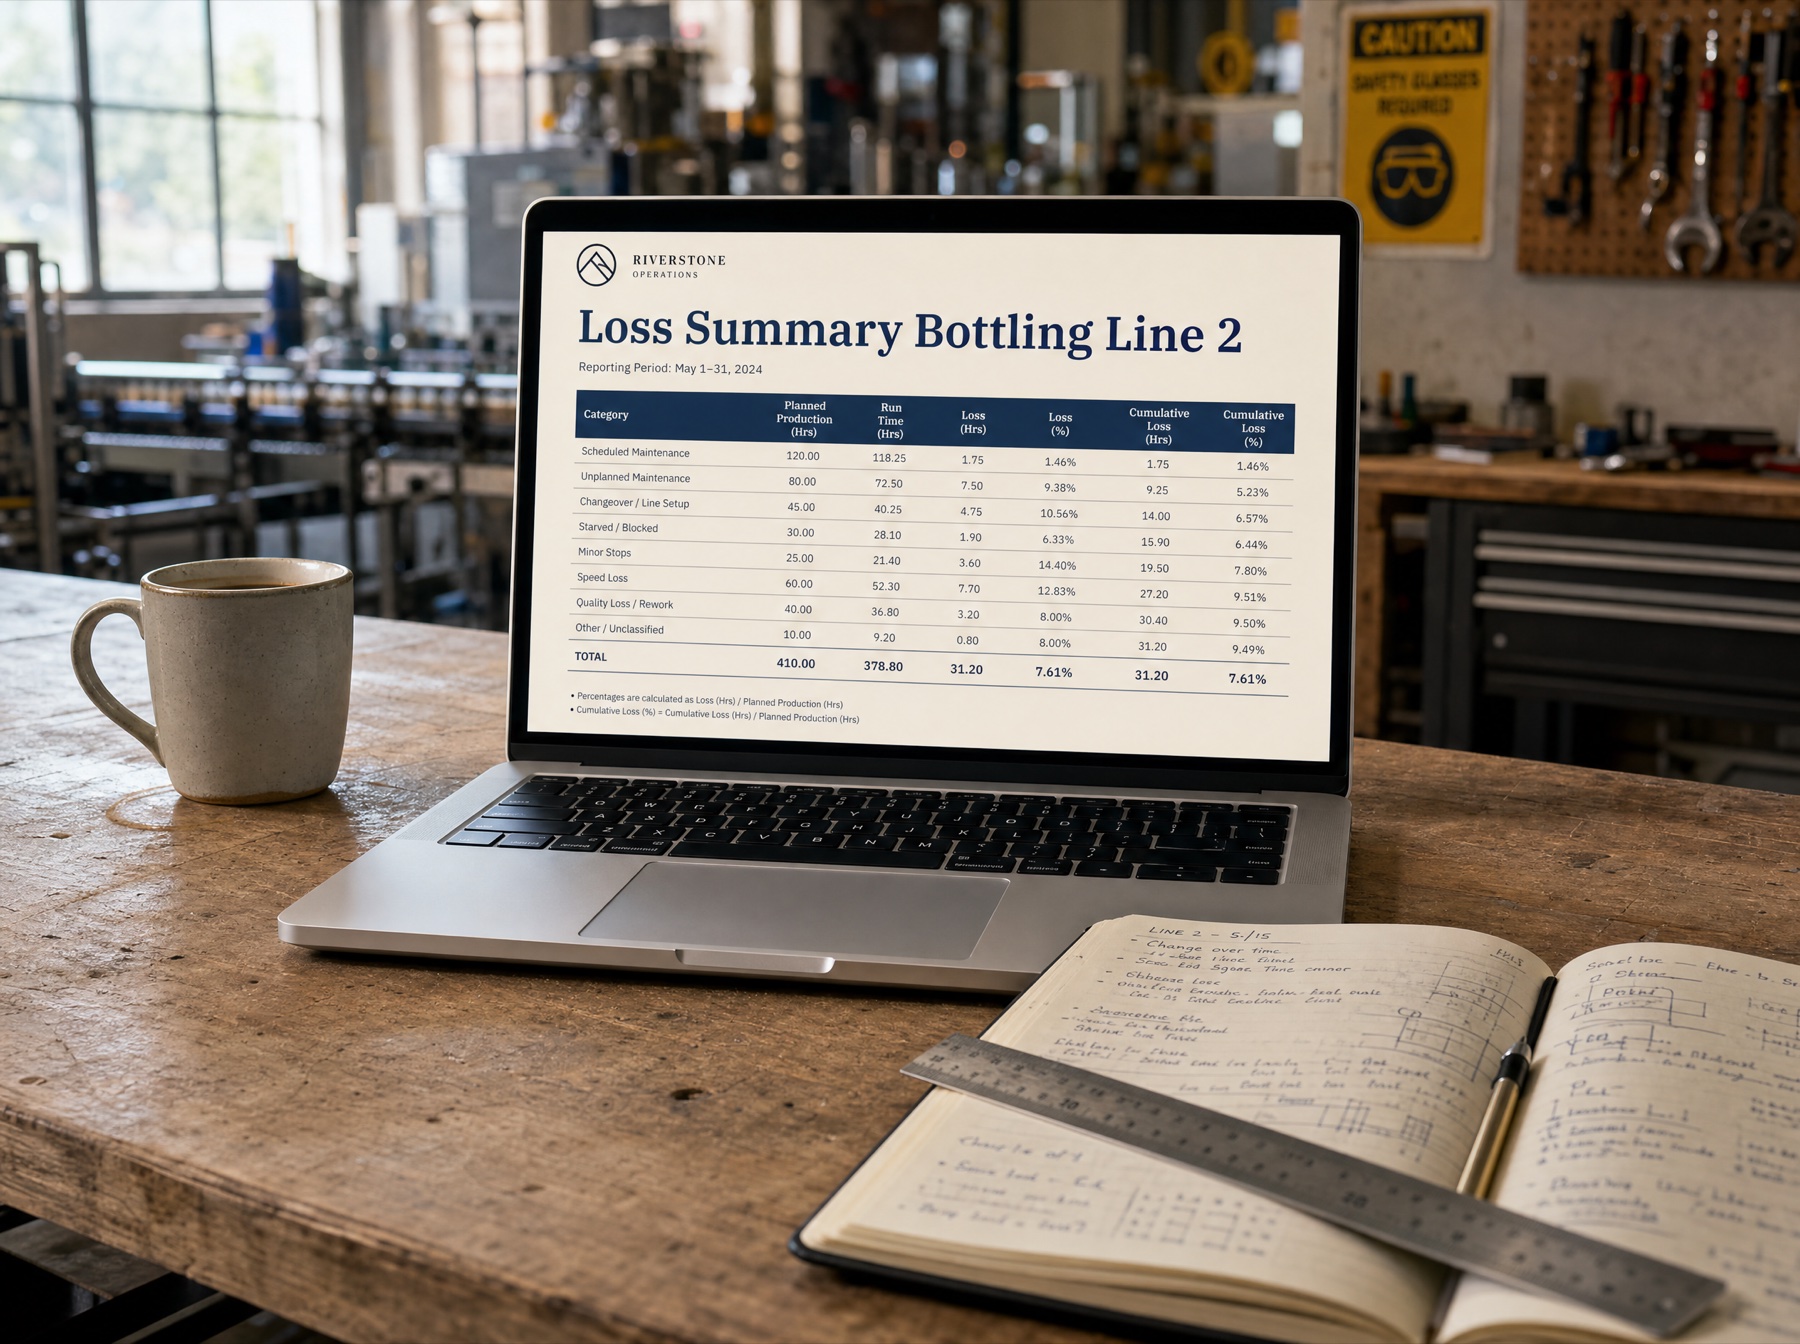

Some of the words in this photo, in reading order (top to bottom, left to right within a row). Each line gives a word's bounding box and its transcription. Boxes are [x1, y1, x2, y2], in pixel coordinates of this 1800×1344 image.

[1360, 19, 1477, 55] CAUTION
[1354, 72, 1406, 93] SAFETY
[1412, 69, 1479, 90] GLASSES
[1377, 97, 1453, 117] REQUIRED
[633, 255, 726, 266] RIVERSTONE
[579, 309, 672, 344] Loss
[686, 310, 903, 357] Summary
[915, 313, 1094, 361] Bottling
[1106, 314, 1204, 353] Line
[1218, 318, 1241, 353] 2
[579, 361, 631, 375] Reporting
[634, 362, 671, 373] Period:
[675, 363, 697, 376] May
[734, 364, 763, 374] 2024
[784, 401, 826, 410] Planned
[881, 403, 902, 412] Run
[584, 409, 629, 422] Category
[962, 410, 986, 420] Loss
[1049, 412, 1073, 422] Loss
[1129, 407, 1190, 418] Cumulative
[1223, 410, 1285, 420] Cumulative
[776, 414, 833, 424] Production
[877, 416, 904, 426] Time
[960, 424, 987, 436] (Hrs)
[1051, 425, 1070, 437] (%)
[1147, 421, 1171, 431] Loss
[1242, 424, 1266, 433] Loss
[791, 427, 817, 438] (Hrs)
[877, 428, 904, 440] (Hrs)
[1145, 434, 1172, 446] (Hrs)
[1244, 436, 1263, 448] (%)
[582, 446, 629, 456] Scheduled
[632, 448, 690, 458] Maintenance
[787, 451, 820, 461] 120.00
[873, 453, 906, 463] 118.25
[962, 455, 984, 465] 1.75
[1045, 457, 1076, 467] 1.46%
[1147, 459, 1169, 469] 1.75
[1237, 461, 1269, 471] 1.46%
[581, 472, 630, 483] Unplanned
[632, 473, 691, 483] Maintenance
[789, 476, 816, 486] 80.00
[875, 479, 903, 488] 72.50
[961, 481, 983, 491] 7.50
[1044, 483, 1076, 493] 9.38%
[1146, 485, 1168, 495] 9.25
[1237, 487, 1269, 497] 5.23%
[580, 497, 634, 509] Changeover
[642, 498, 661, 508] Line
[663, 498, 690, 510] Setup
[787, 502, 815, 512] 45.00
[874, 505, 902, 514] 40.25
[960, 507, 982, 516] 4.75
[1041, 509, 1078, 519] 10.56%
[1142, 511, 1171, 521] 14.00
[1236, 514, 1268, 524] 6.57%
[579, 522, 613, 532] Starved
[622, 523, 658, 533] Blocked
[787, 528, 814, 537] 30.00
[874, 530, 901, 540] 28.10
[960, 532, 982, 542] 1.90
[1043, 535, 1074, 544] 6.33%
[1142, 537, 1170, 547] 15.90
[1235, 540, 1268, 550] 6.44%
[578, 547, 604, 557] Minor
[606, 547, 631, 559] Stops
[786, 553, 814, 563] 25.00
[873, 555, 901, 565] 21.40
[959, 558, 981, 568] 3.60
[1039, 560, 1076, 570] 14.40%
[1141, 563, 1169, 573] 19.50
[1234, 566, 1267, 576] 7.80%
[577, 572, 605, 583] Speed
[608, 573, 628, 583] Loss
[785, 579, 813, 589] 60.00
[872, 581, 900, 591] 52.30
[958, 584, 980, 594] 7.70
[1038, 586, 1076, 596] 12.83%
[1140, 589, 1169, 599] 27.20
[1234, 592, 1266, 602] 9.51%
[576, 597, 608, 609] Quality
[610, 599, 631, 608] Loss
[639, 599, 674, 609] Rework
[784, 605, 812, 614] 40.00
[871, 607, 899, 617] 36.80
[958, 610, 980, 619] 3.20
[1040, 612, 1072, 622] 8.00%
[1139, 615, 1168, 625] 30.40
[1233, 618, 1266, 628] 9.50%
[575, 623, 601, 632] Other
[609, 624, 664, 635] Unclassified
[784, 630, 811, 640] 10.00
[873, 633, 896, 642] 9.20
[957, 635, 979, 645] 0.80
[1039, 638, 1071, 648] 8.00%
[1138, 641, 1167, 651] 31.20
[1232, 644, 1265, 655] 9.49%
[575, 651, 607, 662] TOTAL
[777, 658, 816, 669] 410.00
[864, 660, 903, 672] 378.80
[950, 663, 983, 675] 31.20
[1036, 666, 1073, 678] 7.61%
[1135, 670, 1169, 681] 31.20
[1229, 673, 1267, 685] 7.61%
[577, 692, 625, 703] Percentages
[641, 694, 683, 703] calculated
[696, 696, 714, 704] Loss
[716, 696, 736, 706] (Hrs)
[743, 697, 776, 707] Planned
[777, 699, 822, 708] Production
[823, 700, 843, 710] (Hrs)
[576, 705, 621, 715] Cumulative
[622, 707, 640, 716] Loss
[642, 707, 656, 717] (%)
[665, 708, 710, 718] Cumulative
[711, 710, 730, 719] Loss
[732, 711, 752, 721] (Hrs)
[759, 712, 792, 721] Planned
[793, 713, 838, 723] Production
[839, 715, 860, 725] (Hrs)
[1149, 926, 1184, 936] LINE
[1146, 940, 1203, 953] Change
